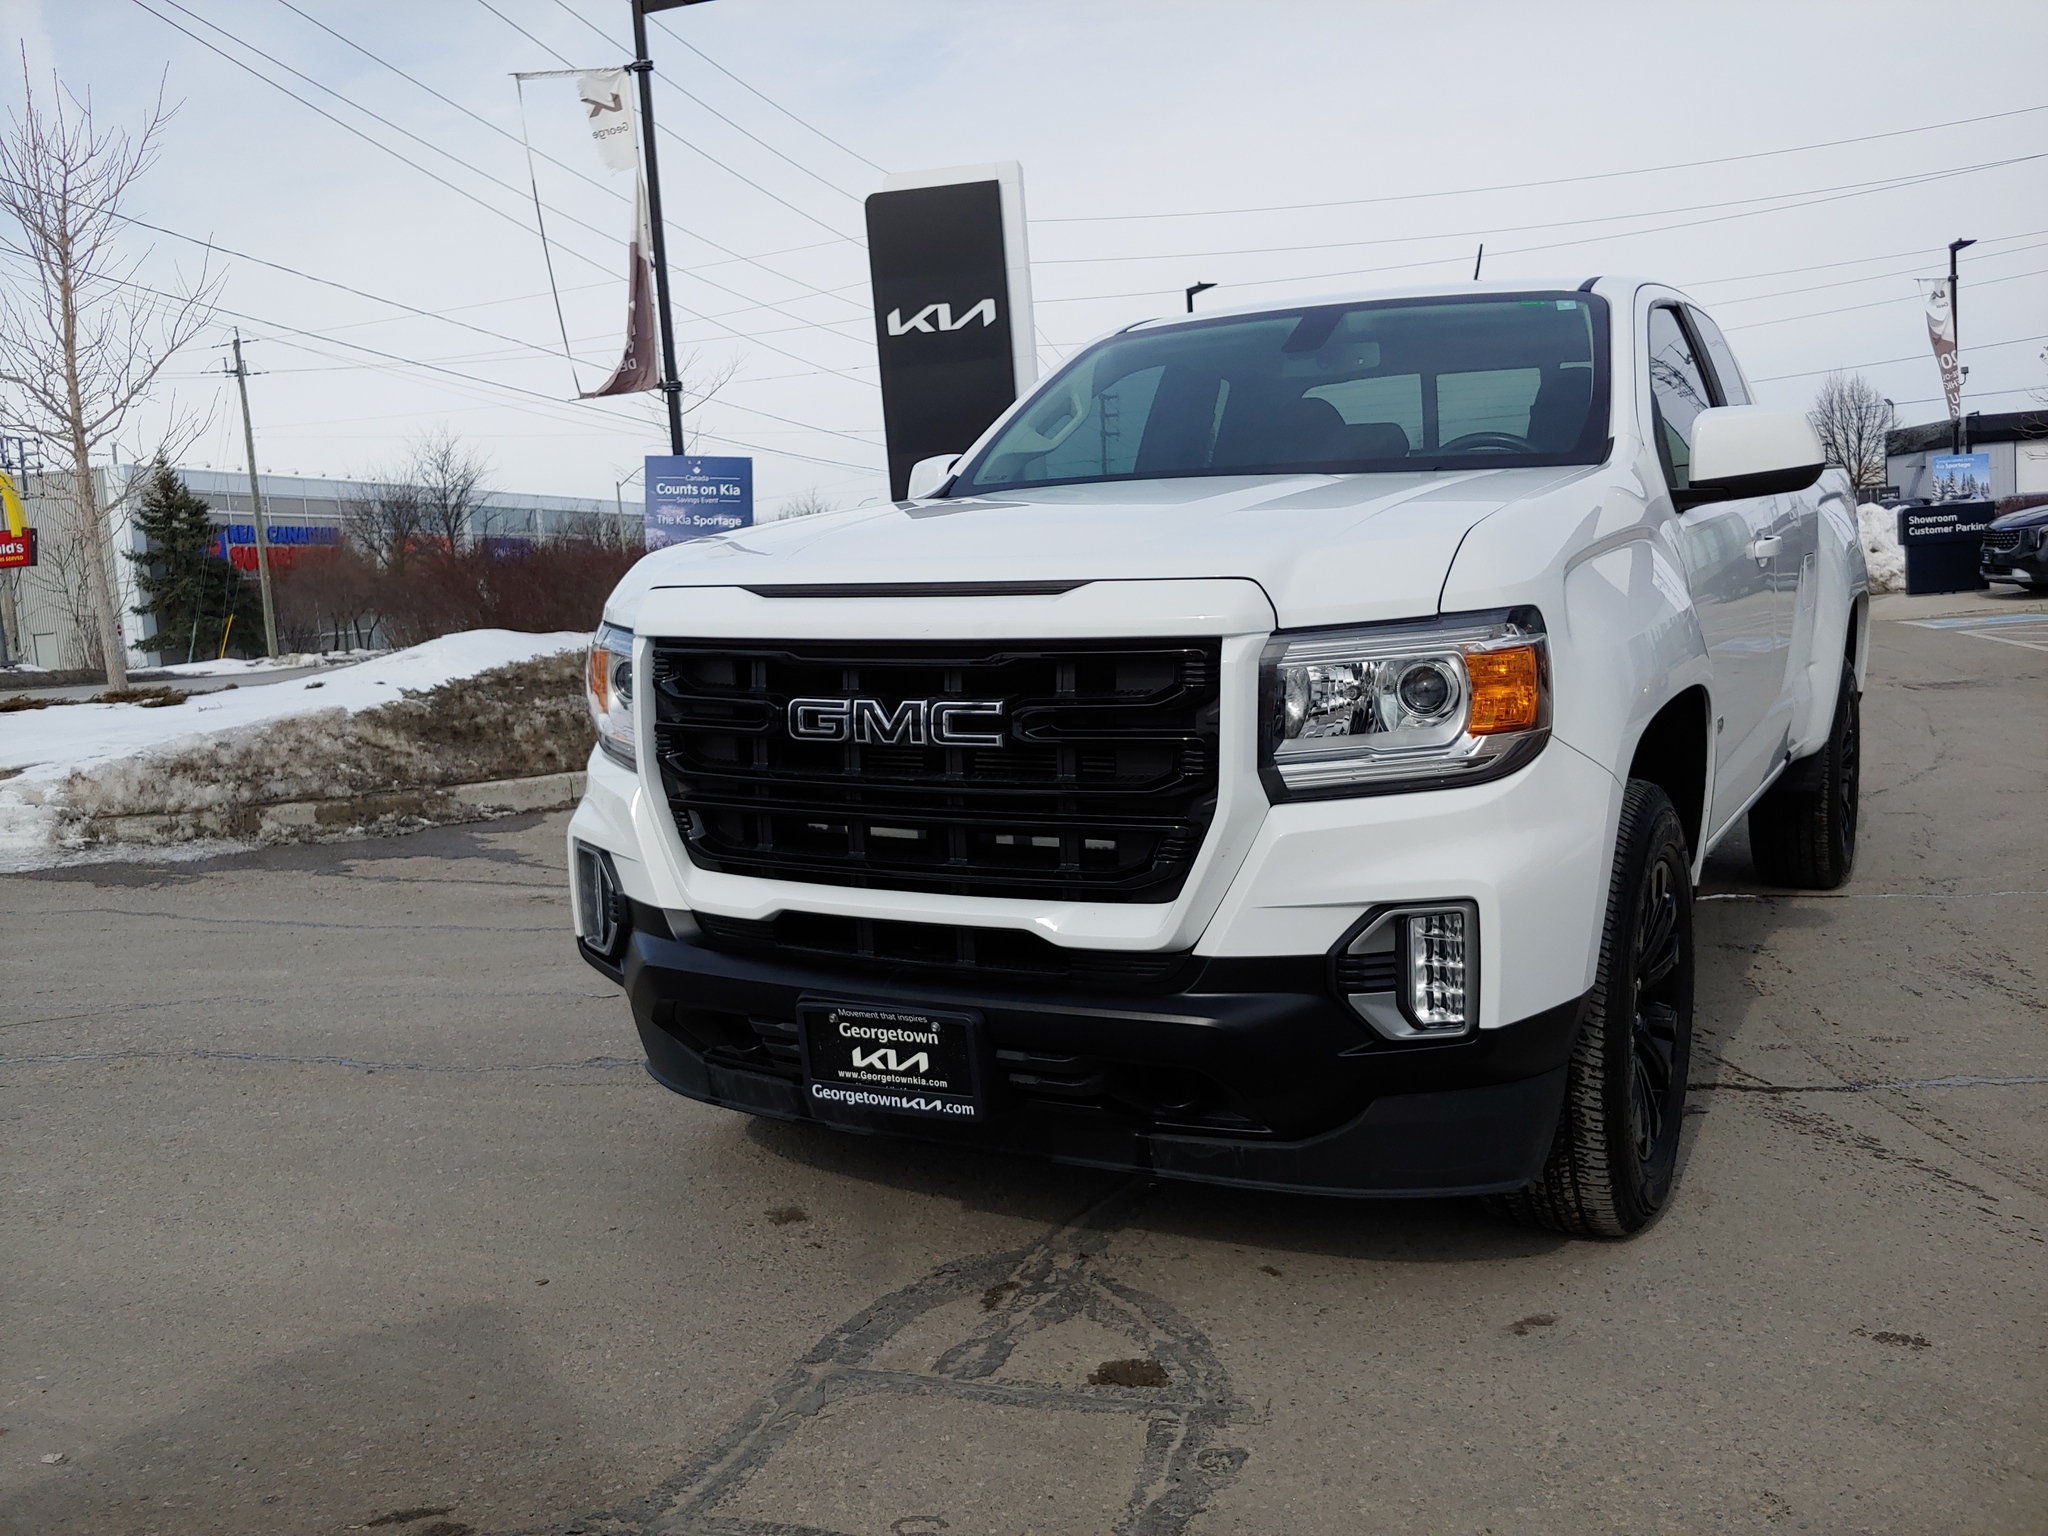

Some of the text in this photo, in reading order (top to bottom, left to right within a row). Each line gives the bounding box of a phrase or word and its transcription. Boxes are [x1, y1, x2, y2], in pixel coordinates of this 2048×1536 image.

[886, 298, 997, 336] KIA
[656, 483, 741, 496] Counts on Kia
[676, 497, 700, 505] Savings
[658, 515, 742, 528] The Kia Sportage
[1908, 514, 1958, 525] Showroom
[1908, 525, 1953, 536] Customer
[787, 698, 1004, 748] GMC
[837, 1008, 928, 1024] Movement that inspires
[838, 1022, 939, 1045] Georgetown
[852, 1046, 930, 1074] KIA
[837, 1069, 949, 1088] www.Georgetownkia.com
